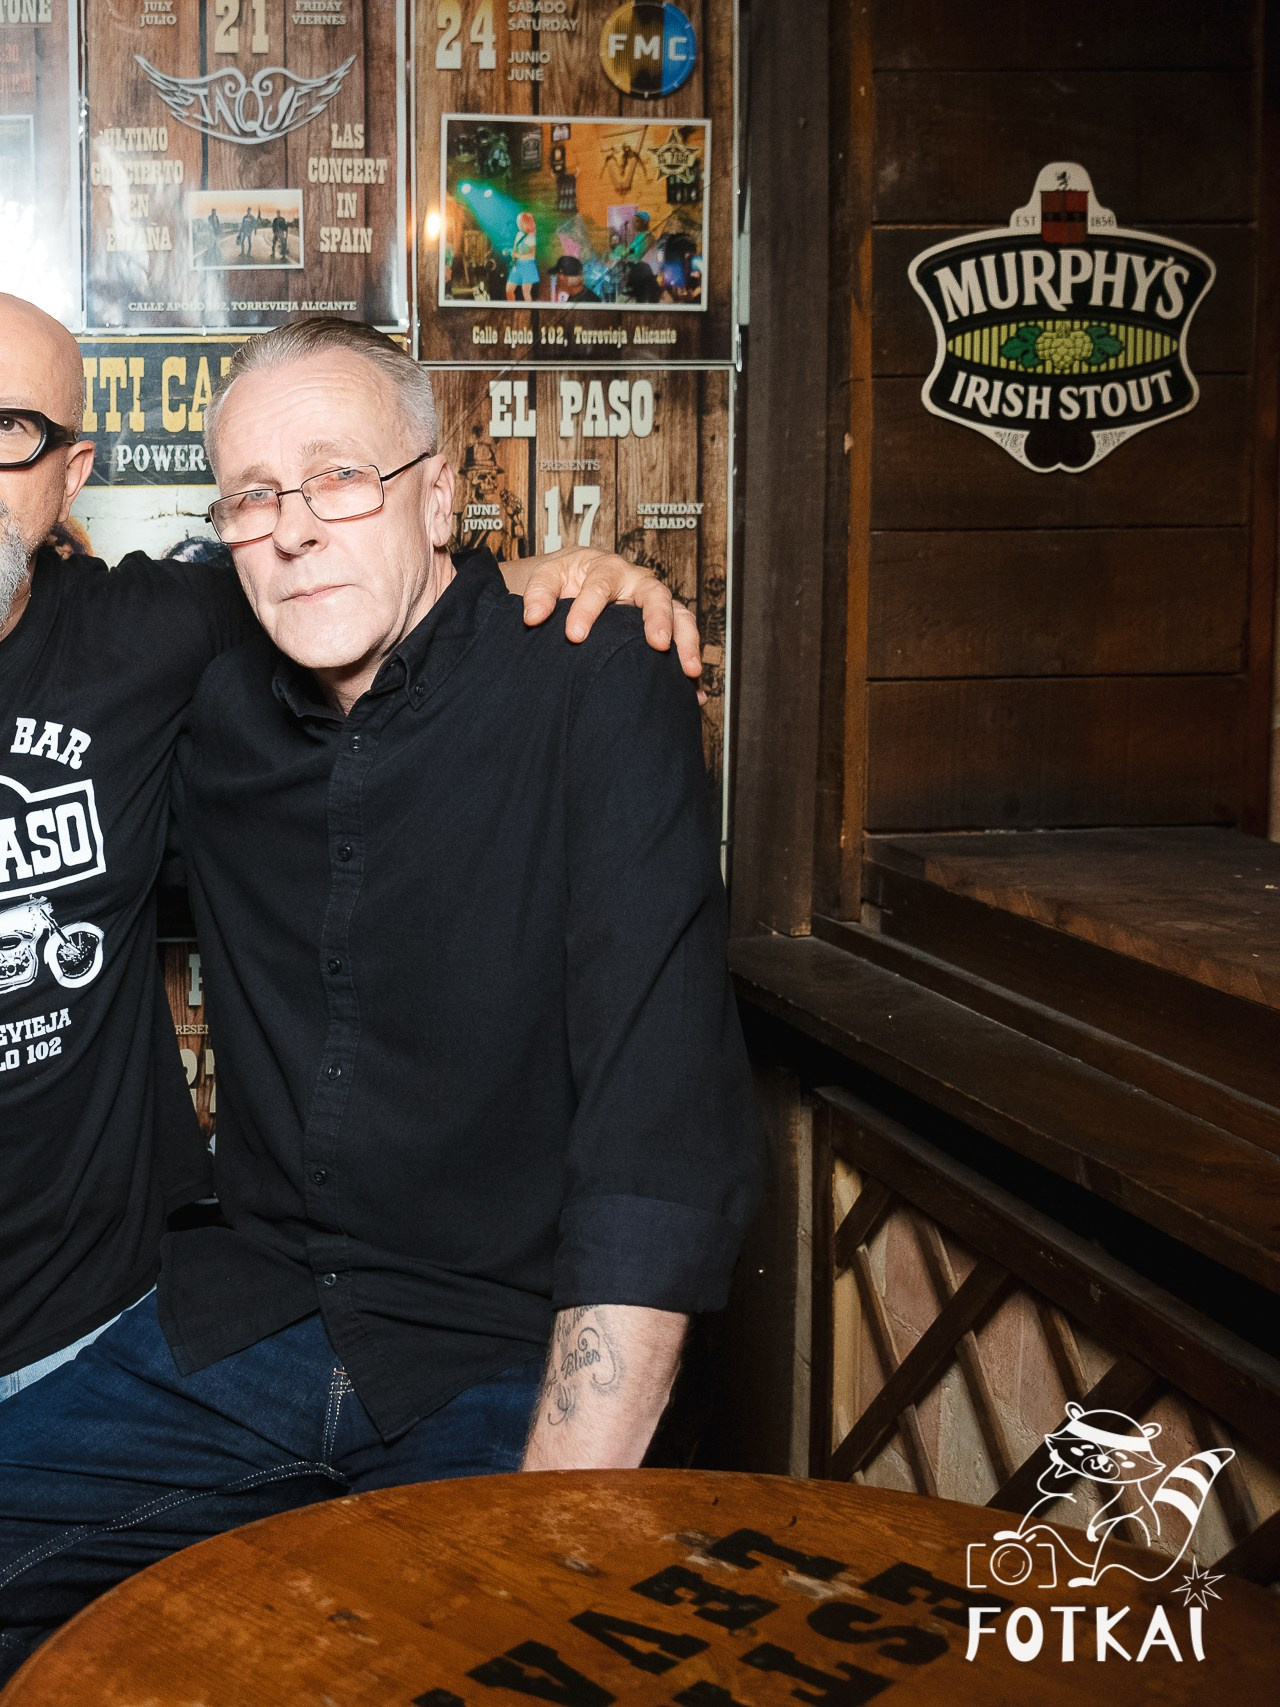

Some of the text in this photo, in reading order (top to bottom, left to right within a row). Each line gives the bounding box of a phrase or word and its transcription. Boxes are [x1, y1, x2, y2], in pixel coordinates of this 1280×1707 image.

[140, 14, 177, 27] JULIO
[214, 0, 269, 54] 21
[292, 13, 347, 26] VIERNES
[507, 18, 580, 32] SATURDAY
[435, 0, 497, 70] 24
[507, 51, 552, 64] JUNIO
[507, 69, 545, 82] JUNE
[330, 123, 366, 150] LAS
[306, 157, 388, 184] CONCERT
[336, 192, 358, 218] IN
[319, 227, 374, 253] SPAIN
[932, 248, 1191, 323] MURPHY'S
[231, 301, 358, 313] TORREVIEJA ALICANTE
[472, 325, 677, 347] Calle Apolo 102, Torrevieja Alicante
[488, 378, 655, 439] EL PASO
[948, 370, 1175, 422] IRISH STOUT
[115, 443, 208, 473] POWER
[540, 459, 601, 472] PRESENTS
[466, 503, 500, 517] JUNE
[543, 485, 601, 555] 17
[636, 502, 705, 516] SATURDAY
[463, 518, 504, 533] JUNIO
[643, 515, 698, 530] SÁBADO
[10, 717, 92, 770] BAR
[26, 1036, 63, 1065] 102
